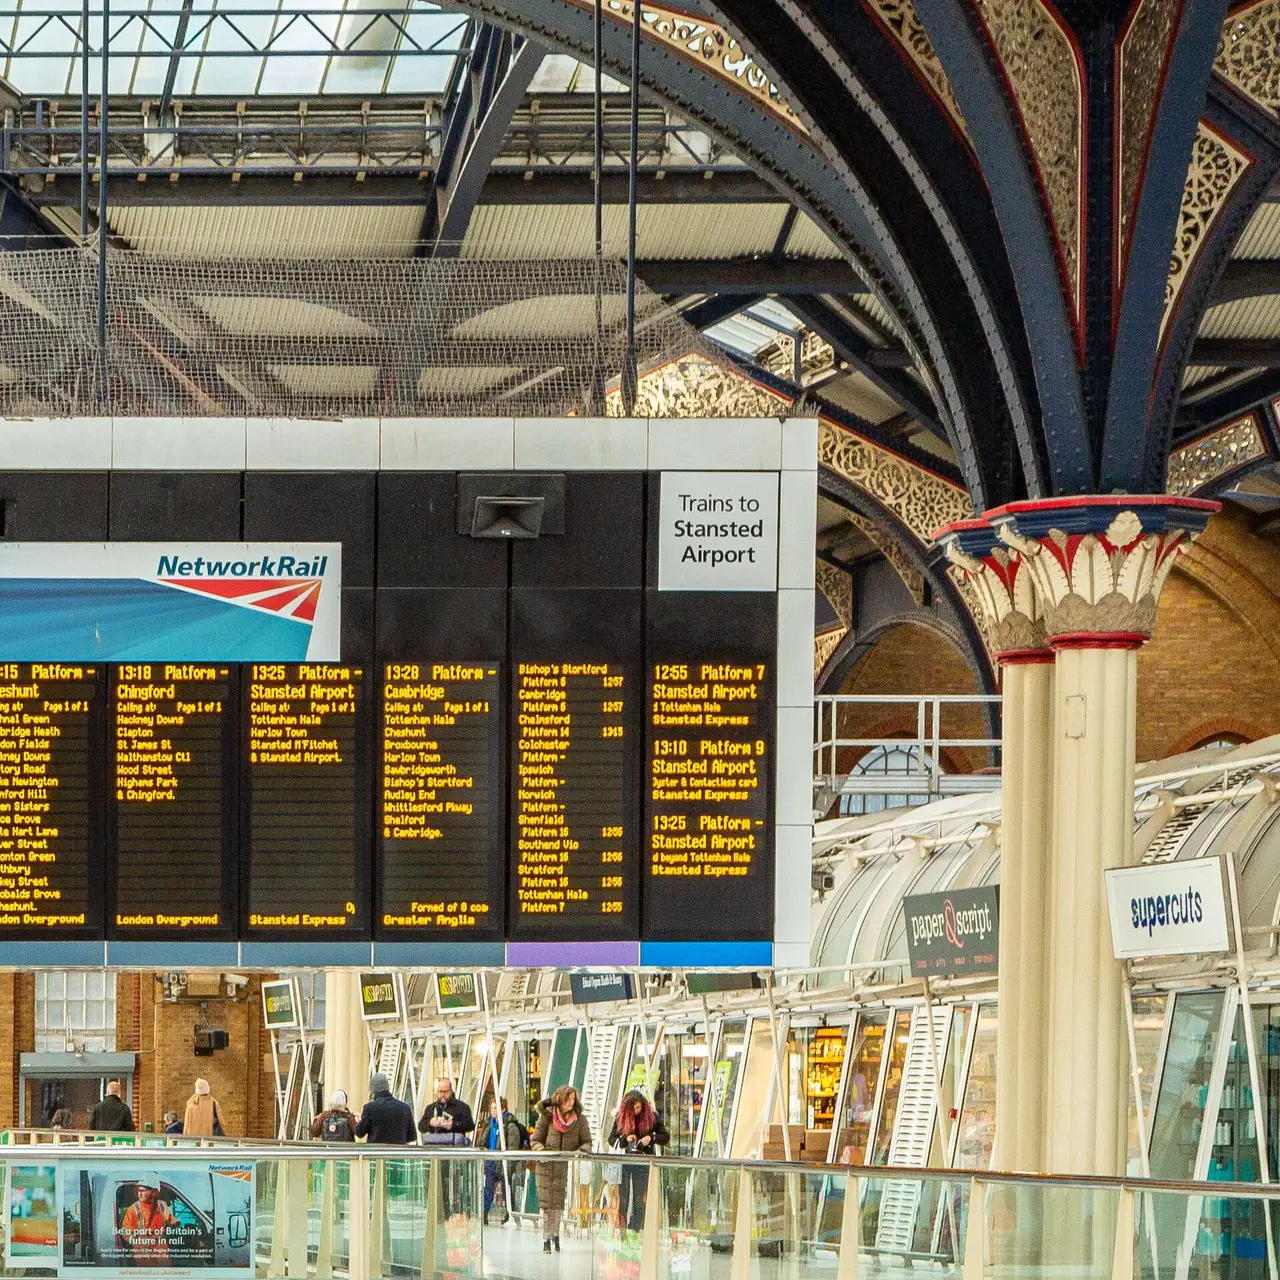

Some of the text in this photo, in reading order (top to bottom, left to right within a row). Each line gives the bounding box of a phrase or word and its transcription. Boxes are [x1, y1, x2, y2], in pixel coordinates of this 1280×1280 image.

[678, 494, 759, 512] Trains to
[675, 520, 762, 537] Stansted
[681, 545, 755, 567] Airport
[158, 556, 327, 576] NetworkRail
[656, 665, 764, 680] 12:55 Platform 7
[654, 684, 757, 700] Stansted Airport
[1131, 886, 1202, 937] supercuts
